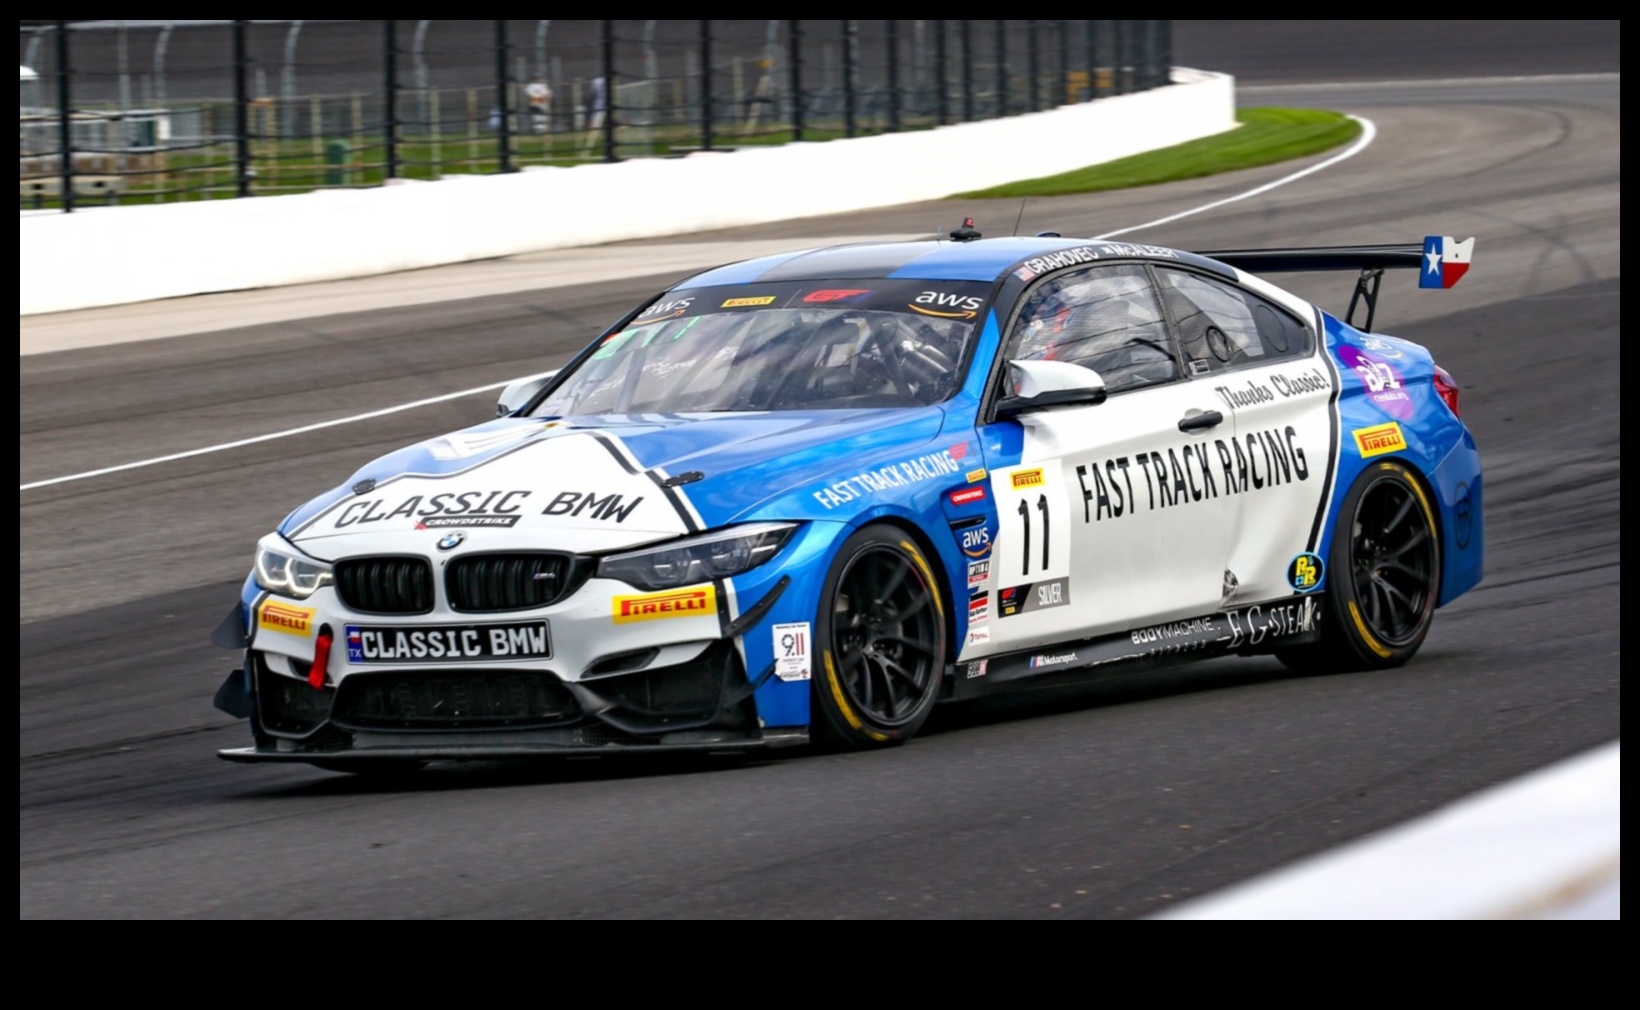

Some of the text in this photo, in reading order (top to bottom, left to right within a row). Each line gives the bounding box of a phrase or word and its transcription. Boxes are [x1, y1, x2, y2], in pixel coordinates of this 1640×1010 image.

[1024, 247, 1099, 273] GRAHOVEC
[915, 290, 984, 310] aws
[1214, 368, 1331, 409] Thanks Classic!
[1358, 427, 1402, 451] PIRELLI
[812, 480, 861, 510] FAST
[852, 464, 909, 493] TRACK
[901, 450, 960, 486] RACING
[1012, 470, 1042, 487] PIRELLI
[1076, 425, 1310, 523] FAST TRACK RACING
[334, 490, 645, 528] CLASSIC BMW
[425, 516, 514, 527] CROWDSTRIKE
[963, 527, 989, 548] aws
[1018, 493, 1050, 576] 11
[620, 591, 706, 617] PIRELLI
[1038, 582, 1062, 606] SILVER
[262, 604, 309, 631] PIRELLI
[1131, 616, 1215, 645] BODYMACHINE
[349, 647, 362, 658] TX
[360, 626, 547, 659] CLASSIC BMW
[1045, 652, 1078, 667] Motorsport
